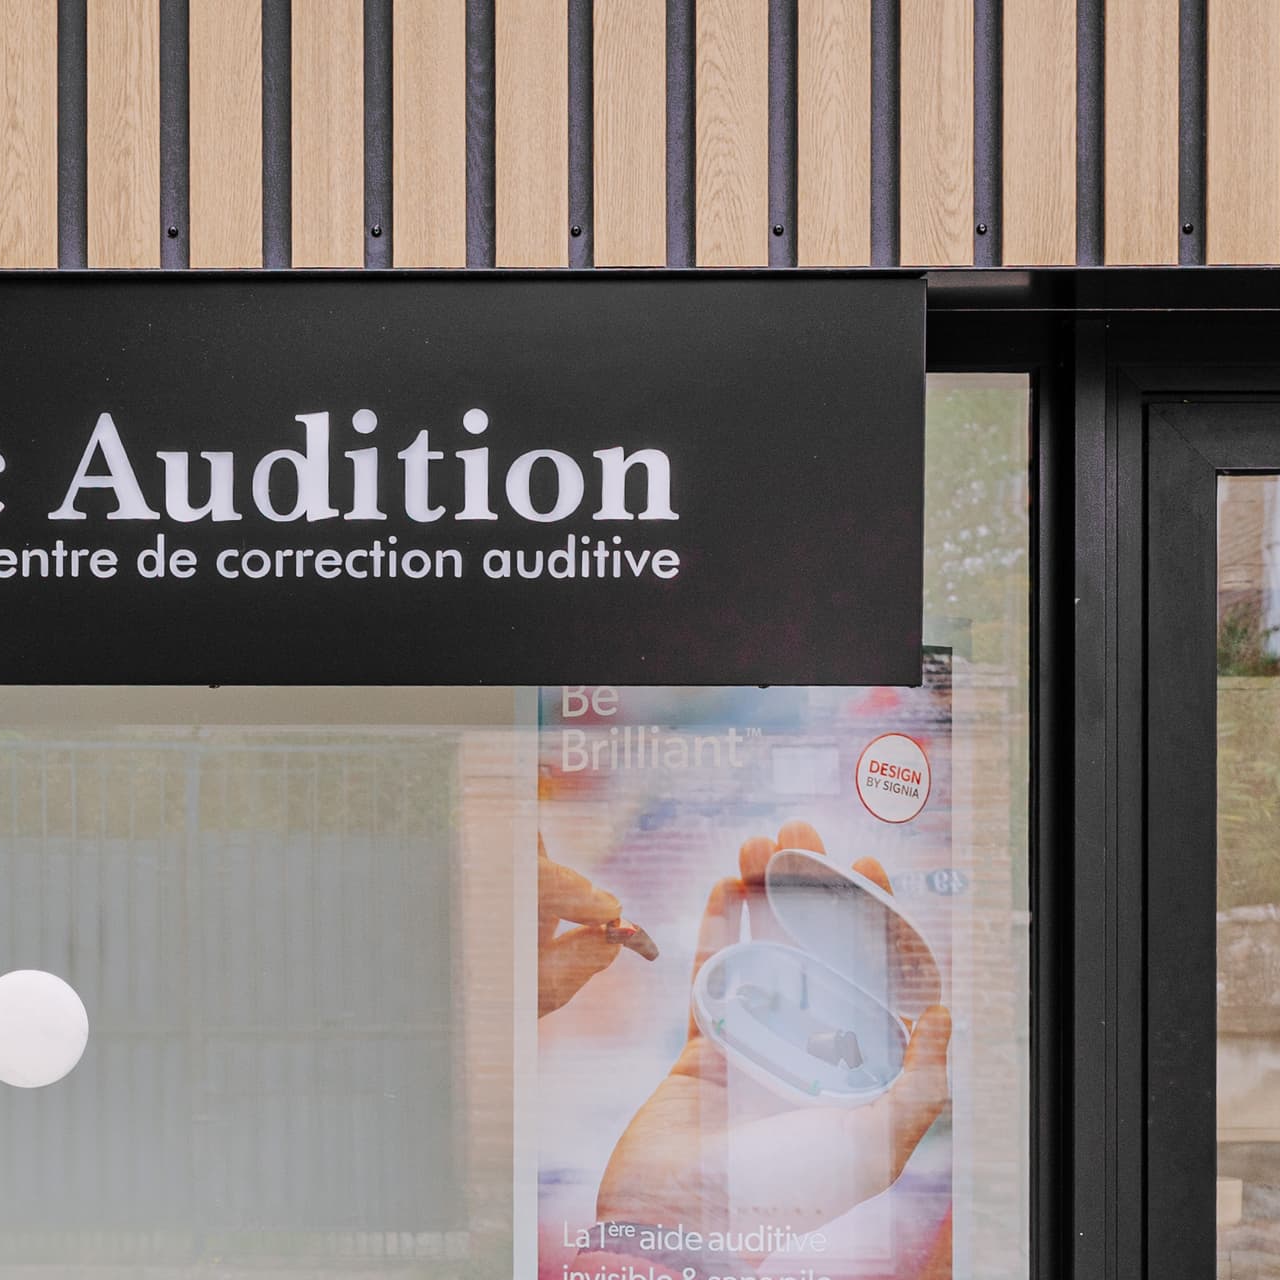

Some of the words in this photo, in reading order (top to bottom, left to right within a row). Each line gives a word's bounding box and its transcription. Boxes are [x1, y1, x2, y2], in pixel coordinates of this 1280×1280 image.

[51, 409, 681, 523] Audition
[137, 535, 196, 579] de
[217, 537, 464, 579] correction
[482, 534, 682, 579] auditive
[561, 686, 619, 718] Be
[865, 776, 881, 790] BY
[882, 779, 921, 800] SIGNIA
[868, 759, 923, 785] DESIGN
[562, 1220, 591, 1250] La
[639, 1223, 703, 1253] aide
[707, 1223, 828, 1254] auditive
